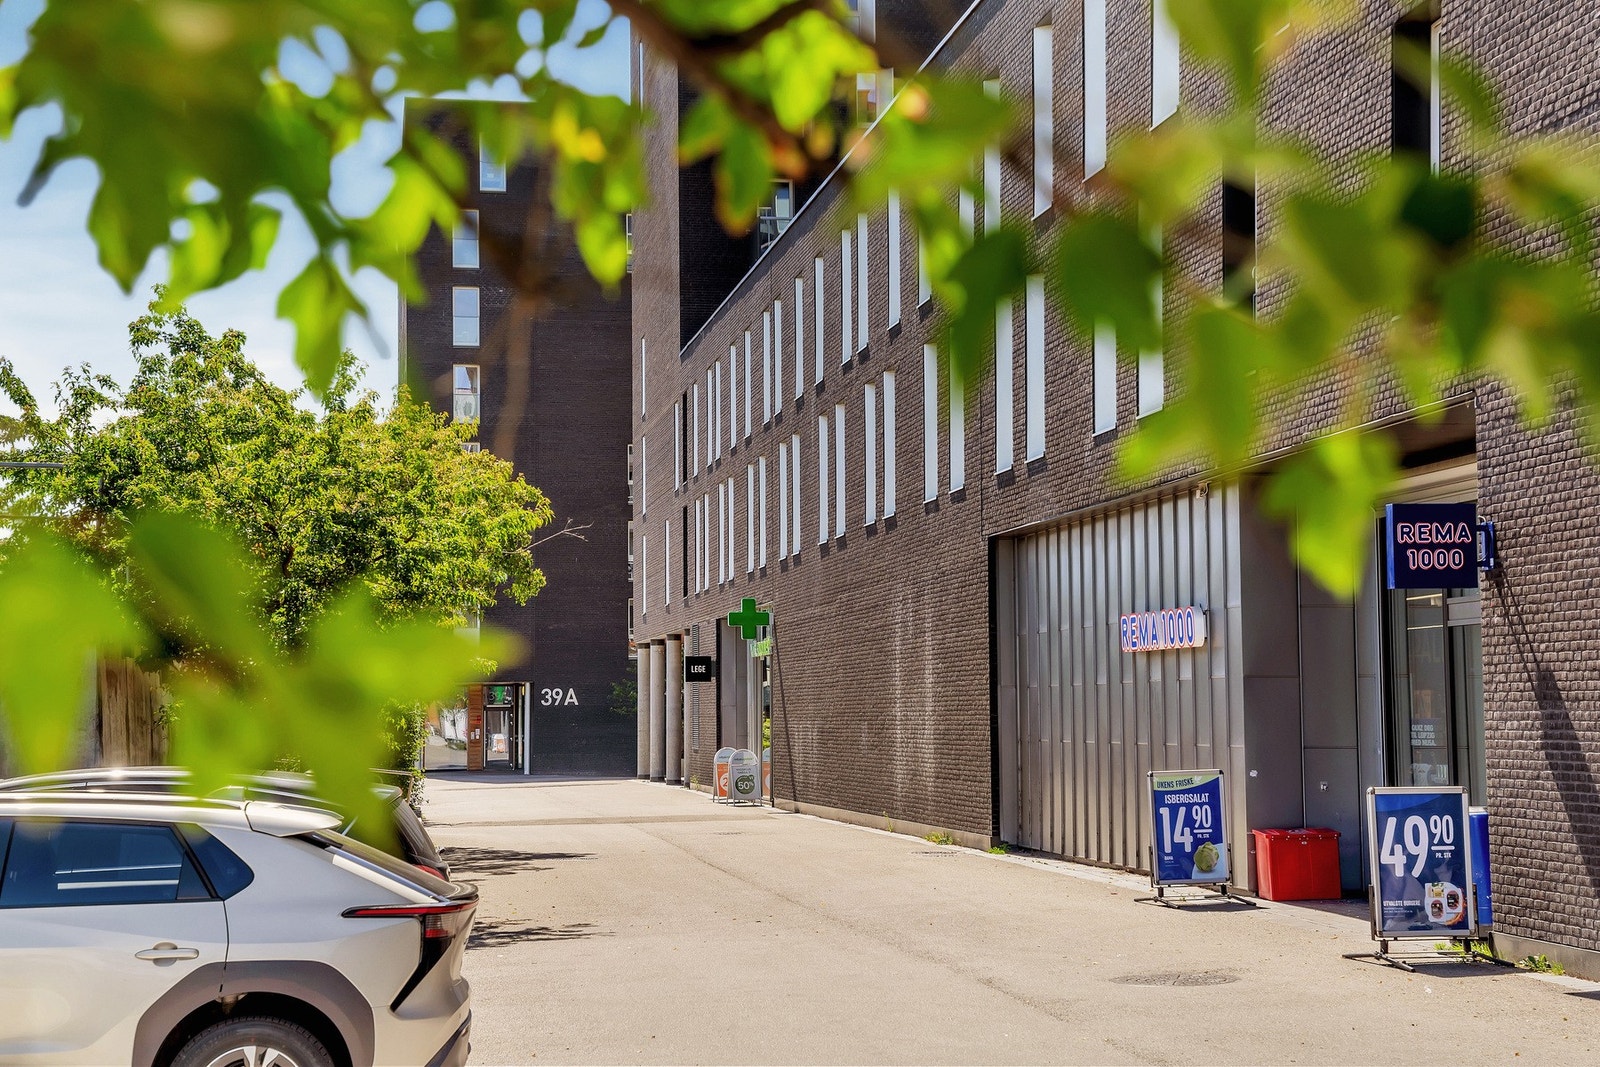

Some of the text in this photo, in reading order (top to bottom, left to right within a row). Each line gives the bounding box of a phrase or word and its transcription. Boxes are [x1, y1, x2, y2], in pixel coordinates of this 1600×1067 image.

[1397, 522, 1472, 544] REMA
[1407, 549, 1464, 570] 1000
[1121, 606, 1195, 652] REMA 1000
[691, 665, 706, 673] LEGE
[540, 687, 579, 706] 39A
[1157, 777, 1194, 789] UKENS FRISKE
[1164, 793, 1209, 804] ISBERGSALAT
